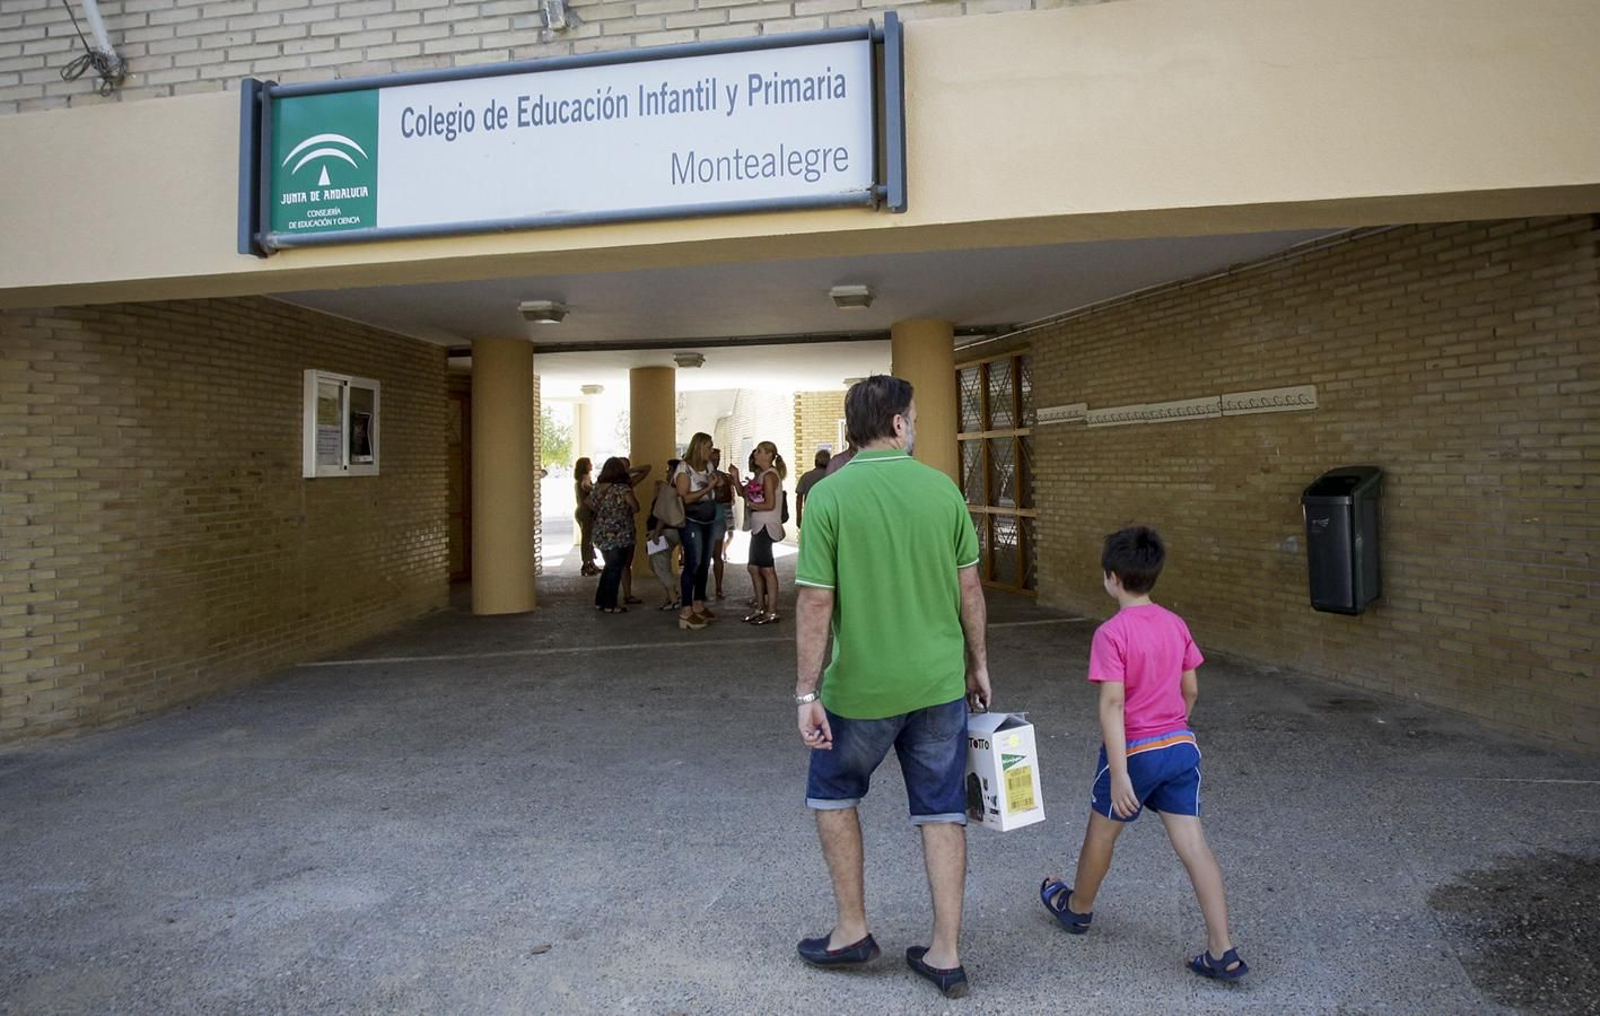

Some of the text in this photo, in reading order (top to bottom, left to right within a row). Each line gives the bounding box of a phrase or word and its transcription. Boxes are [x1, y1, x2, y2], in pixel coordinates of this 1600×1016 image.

[401, 66, 846, 142] Colegio de Educación Infantil y Primaria
[671, 143, 849, 185] Montealegre
[281, 187, 368, 204] JUNTA DE ANDALUCIA
[307, 206, 341, 217] CONSEJERÍA
[288, 221, 297, 229] DE
[298, 217, 332, 228] EDUCACIÓN
[338, 216, 360, 225] CIENCIA
